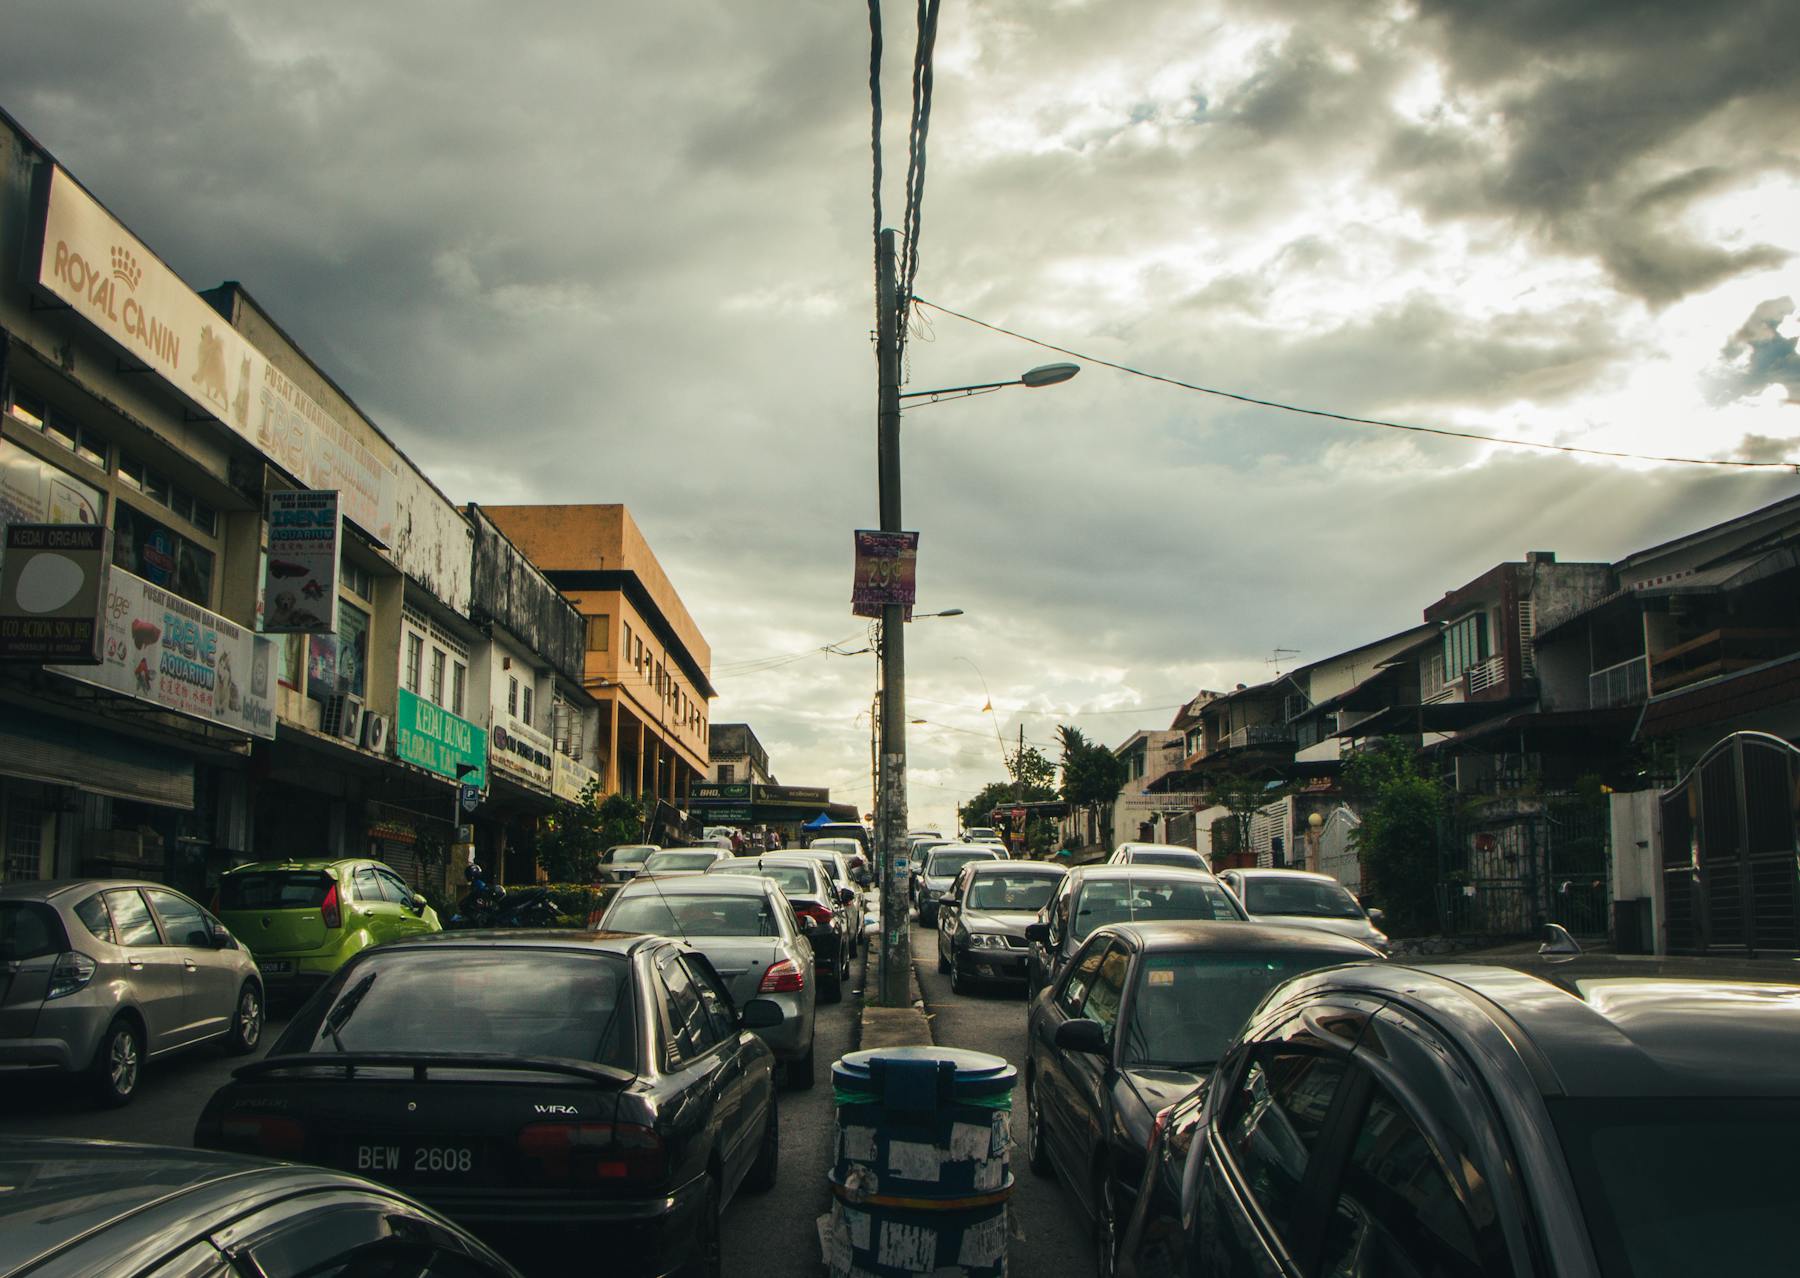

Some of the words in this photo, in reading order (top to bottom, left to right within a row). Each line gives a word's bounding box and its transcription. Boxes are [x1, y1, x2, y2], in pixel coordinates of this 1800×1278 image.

[54, 240, 117, 323] ROYAL
[123, 298, 180, 369] CANIN
[264, 364, 293, 402] PUSAT
[272, 508, 335, 527] IRENE
[272, 529, 334, 540] AQUARIUM
[13, 531, 45, 546] KEDAI
[48, 530, 95, 547] ORGANIK
[143, 583, 165, 606] PUSAT
[166, 595, 201, 623] AKUARIUM
[2, 621, 18, 637] ECO
[22, 620, 53, 638] ACTION
[55, 621, 72, 639] SDN
[162, 612, 217, 667] IRENE
[160, 655, 215, 691] AQUARIUM
[415, 700, 443, 740] KEDAI
[444, 714, 472, 754] BUNGA
[400, 728, 437, 768] FLORAL
[534, 1104, 579, 1115] WIRA
[357, 1146, 400, 1171] BEW
[414, 1147, 472, 1172] 2608
